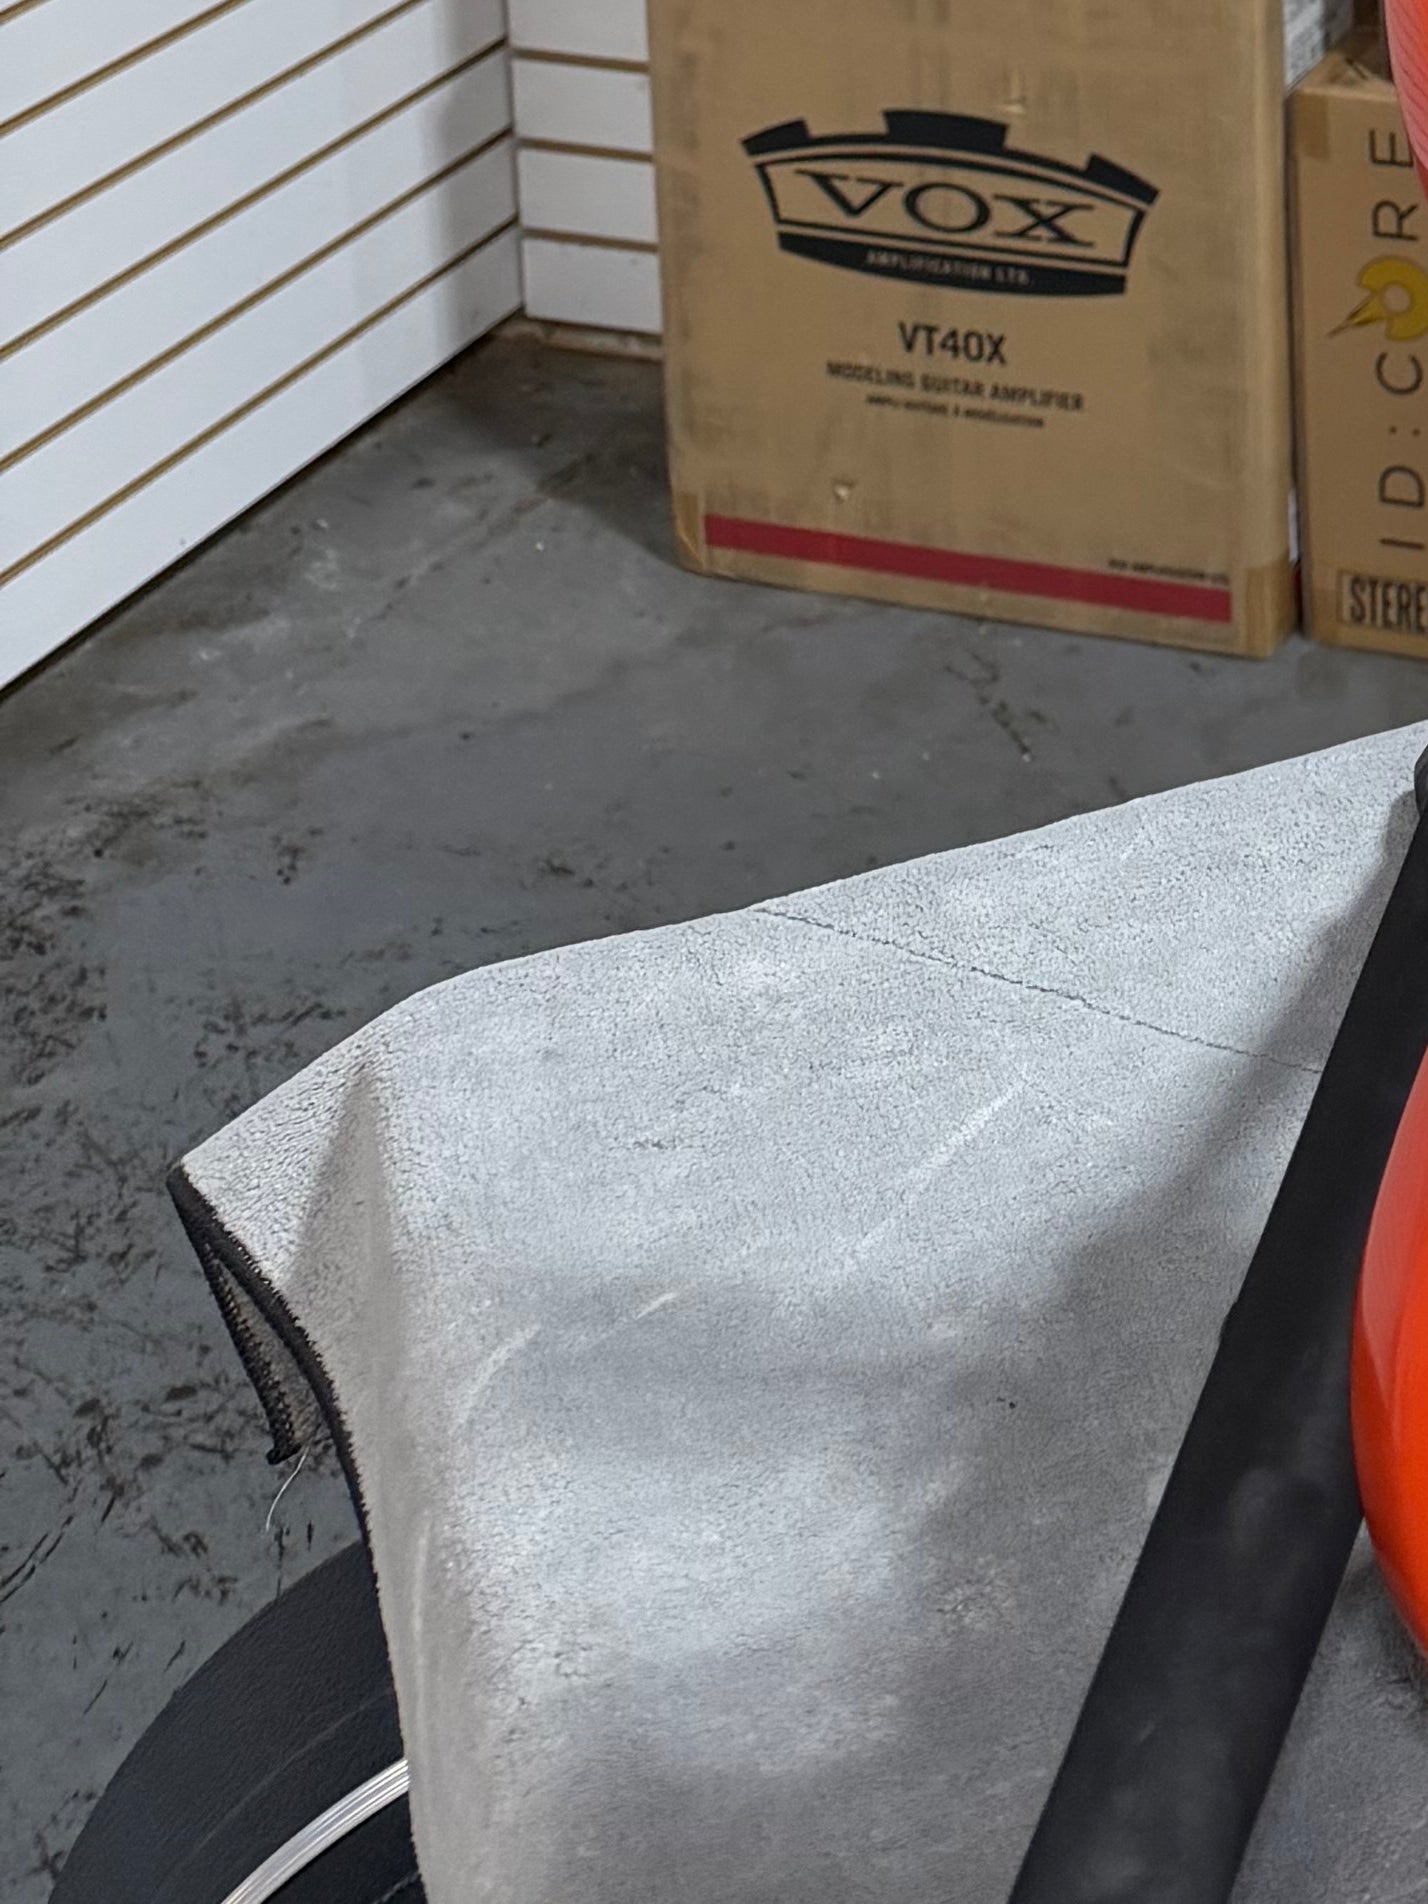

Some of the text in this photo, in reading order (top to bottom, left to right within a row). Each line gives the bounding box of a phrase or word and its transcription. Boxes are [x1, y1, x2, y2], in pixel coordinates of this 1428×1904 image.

[794, 168, 1096, 249] VOX
[865, 249, 992, 281] AMPLIFICATION
[898, 320, 1009, 366] VT40X
[825, 360, 917, 390] MODELING
[920, 372, 986, 401] GUITAR
[988, 383, 1085, 412] AMPLIFIER
